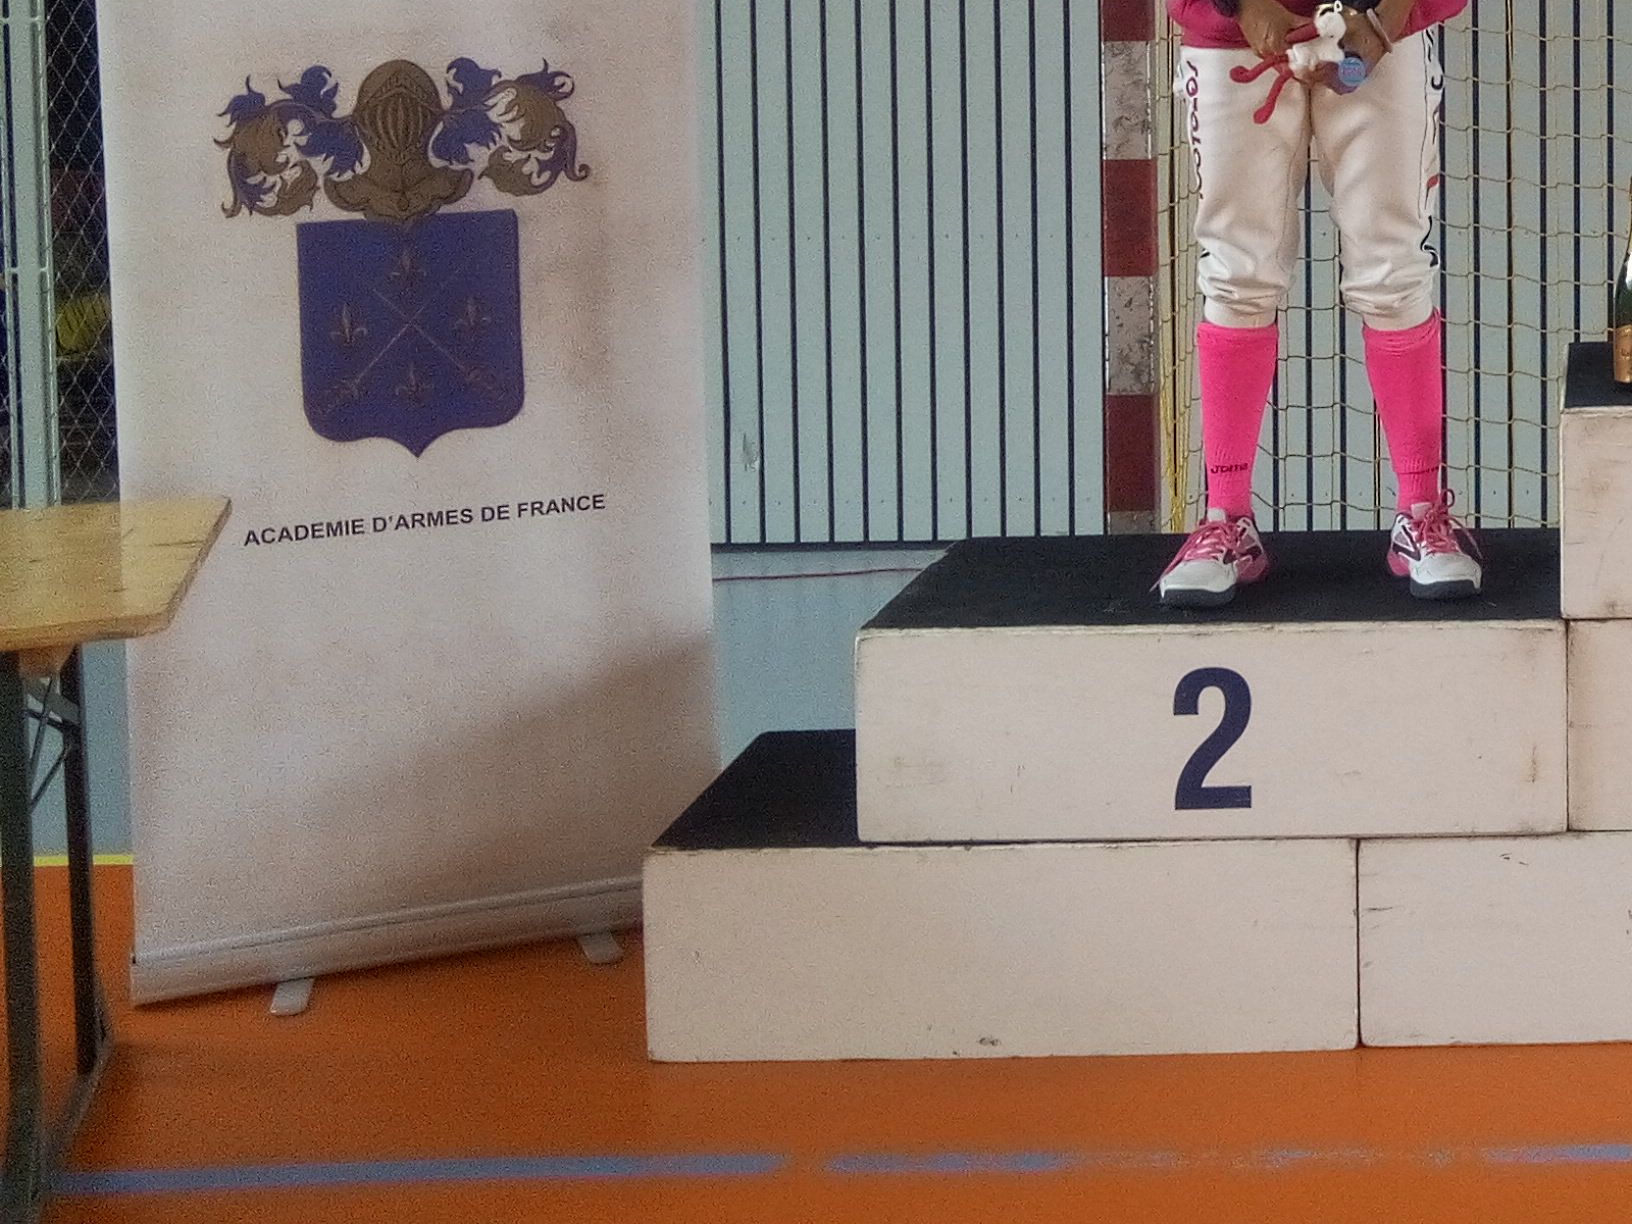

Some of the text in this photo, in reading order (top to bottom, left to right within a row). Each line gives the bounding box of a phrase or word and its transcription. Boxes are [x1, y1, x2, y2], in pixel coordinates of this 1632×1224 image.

[244, 493, 607, 547] ACADEMIE D'ARMES DE FRANCE
[1173, 667, 1252, 810] 2
